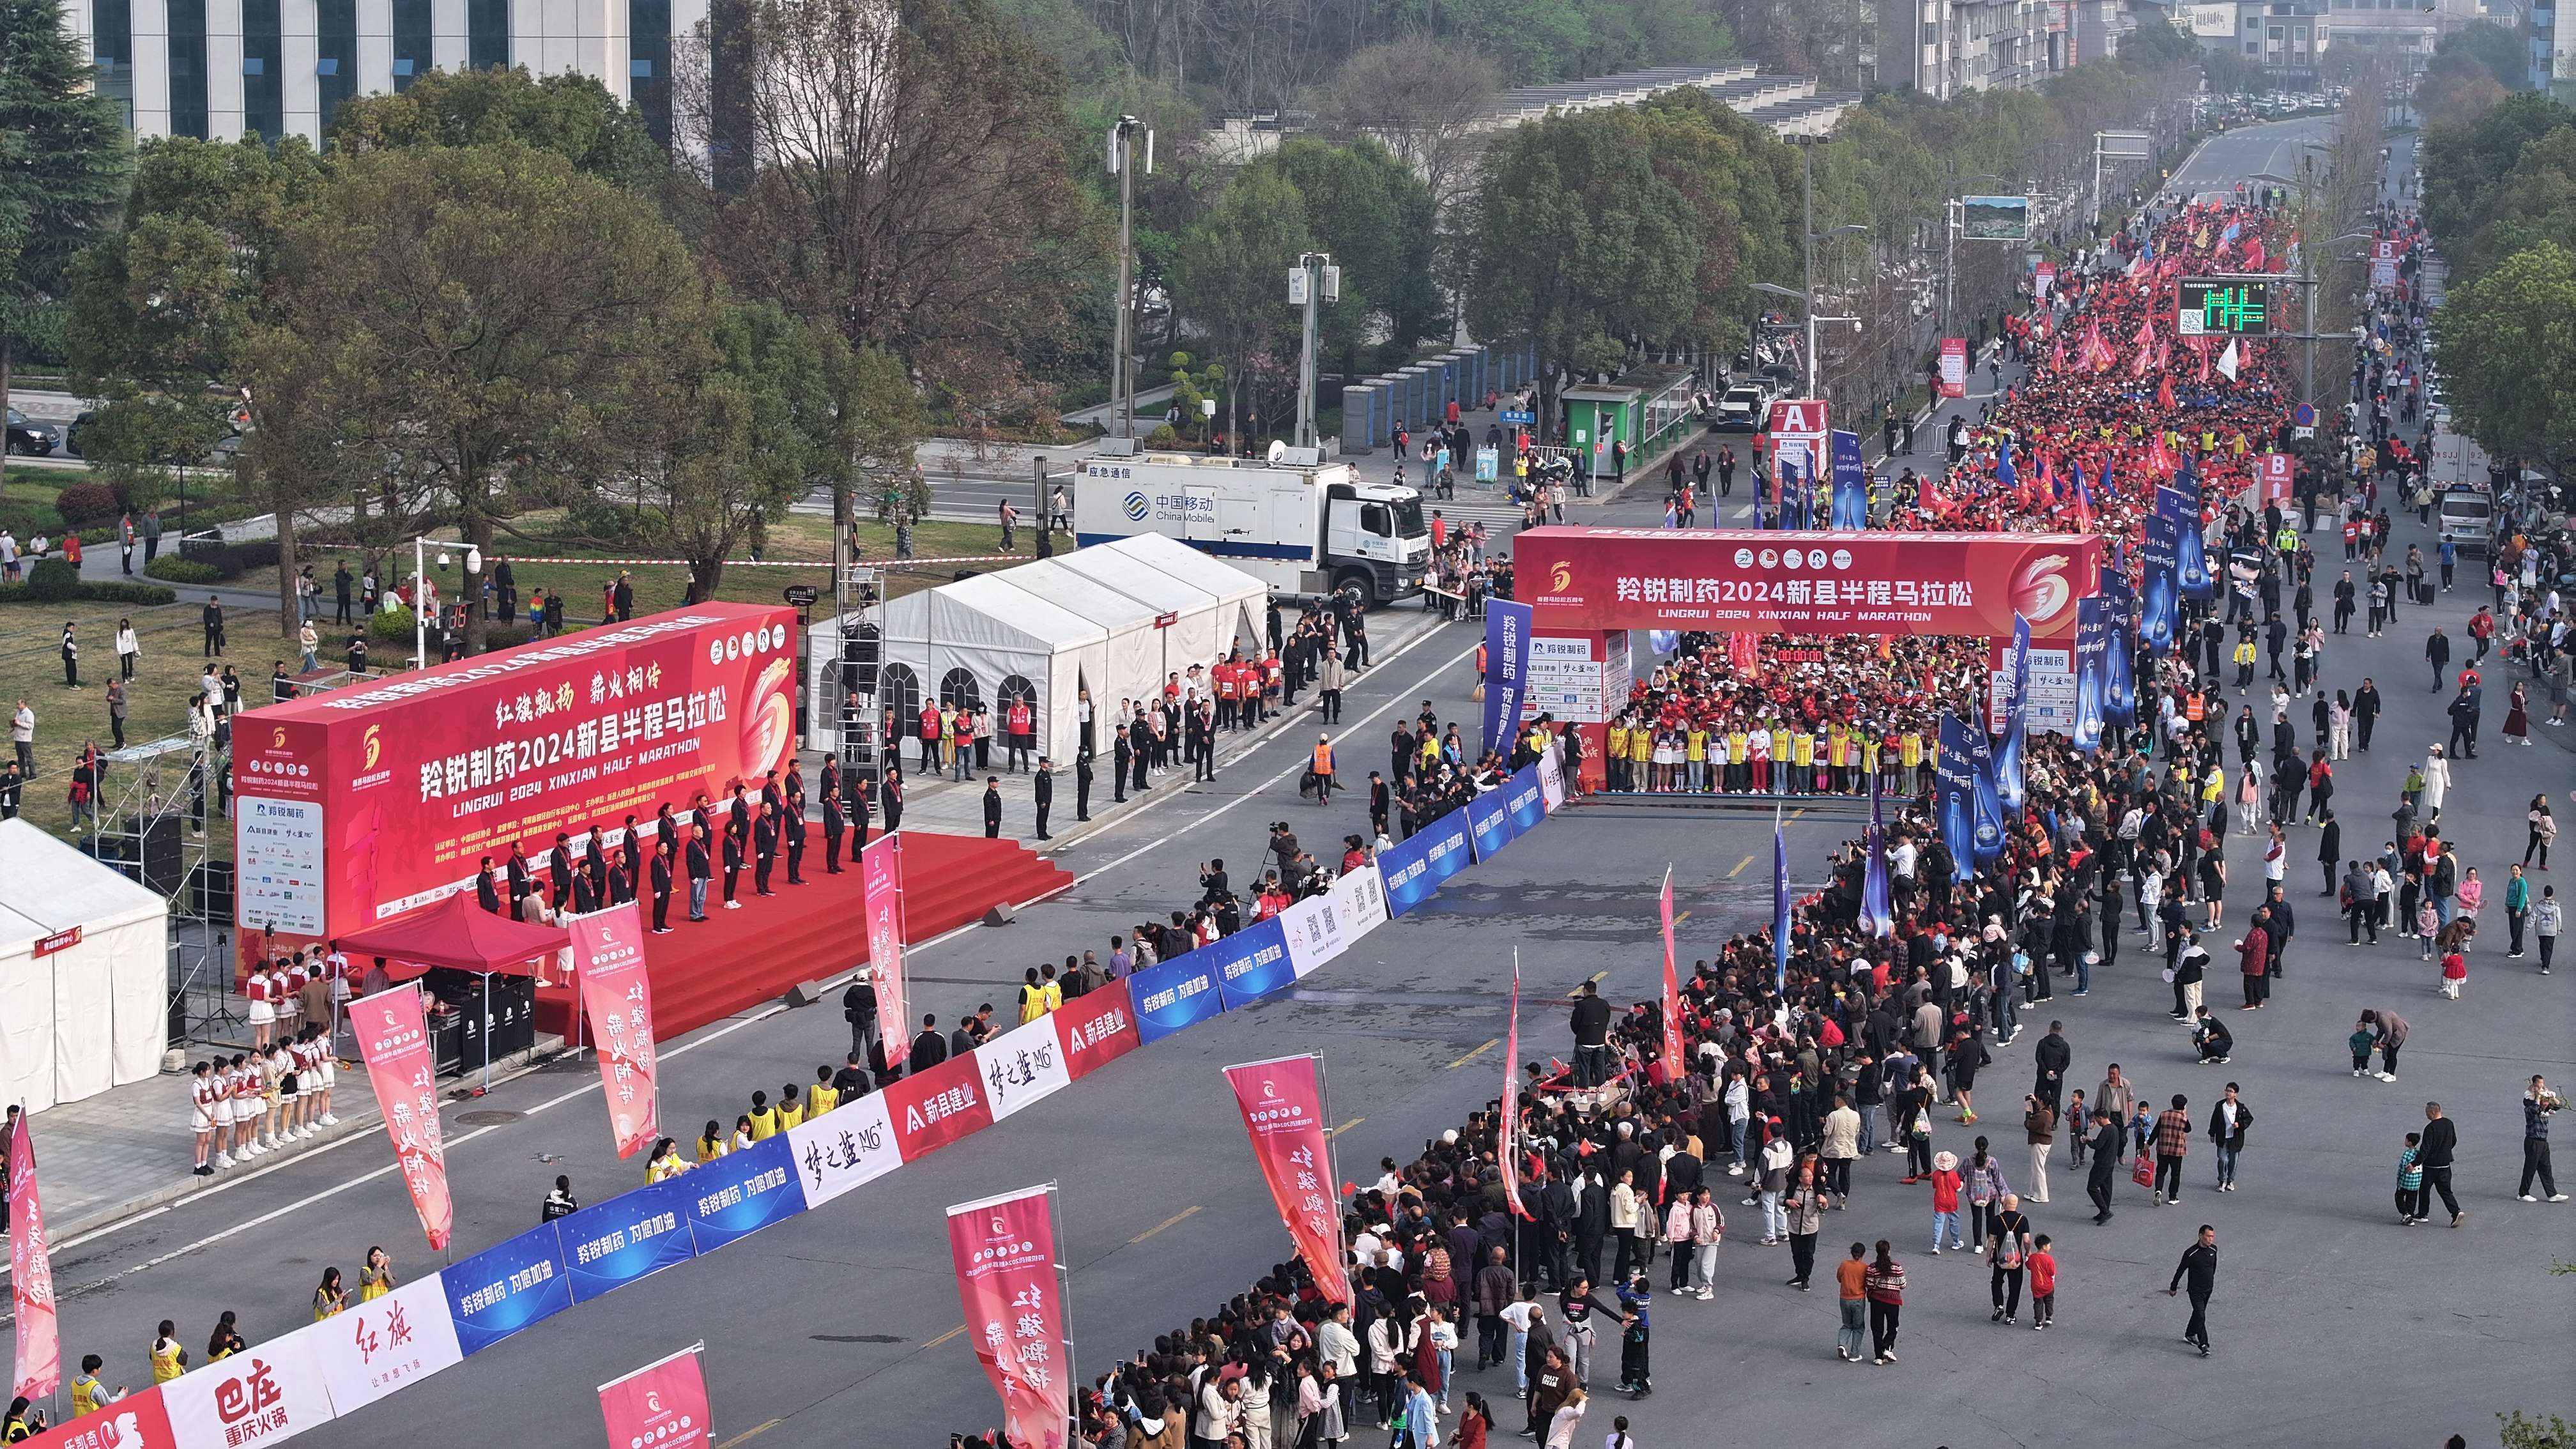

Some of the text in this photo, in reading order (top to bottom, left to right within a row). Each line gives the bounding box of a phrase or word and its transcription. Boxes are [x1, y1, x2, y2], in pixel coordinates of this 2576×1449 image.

[1783, 406, 1807, 431] A
[1089, 466, 1131, 479] 应急通信
[2272, 456, 2285, 474] B
[1156, 493, 1213, 511] 中国移动
[1156, 510, 1214, 523] China Mobile
[1616, 577, 1973, 606] 羚锐制药2024新县半程马拉松
[1658, 609, 1932, 622] LINGRUI 2024 XINXIAN HALF MARATHON
[1503, 615, 1516, 680] 羚锐制药
[1547, 643, 1586, 656] 羚锐制药
[496, 659, 663, 731] 红旗飘扬 薪火相传
[420, 684, 727, 804] 羚锐制药2024新县半程马拉松
[452, 737, 701, 818] LINGRUI 2024 XINXIAN HALF MARATHON
[268, 805, 304, 819] 羚锐制药
[1429, 832, 1463, 864] 羚锐制药 为您加油
[1388, 858, 1426, 891] 羚锐制药 为您加油
[1224, 944, 1282, 981] 羚锐制药 为您加油
[1143, 974, 1209, 1015] 羚锐制药 为您加油
[1084, 1006, 1126, 1046] 新县建业
[922, 1081, 977, 1126] 新县建业
[697, 1165, 787, 1218] 羚锐制药 为您加油
[576, 1211, 676, 1265] 羚锐制药 为您加油
[461, 1258, 554, 1318] 羚锐制药 为您加油
[355, 1299, 413, 1366] 红旗
[215, 1358, 282, 1425] 巴庄
[371, 1358, 422, 1390] 让理想飞扬
[224, 1404, 289, 1448] 重庆火锅
